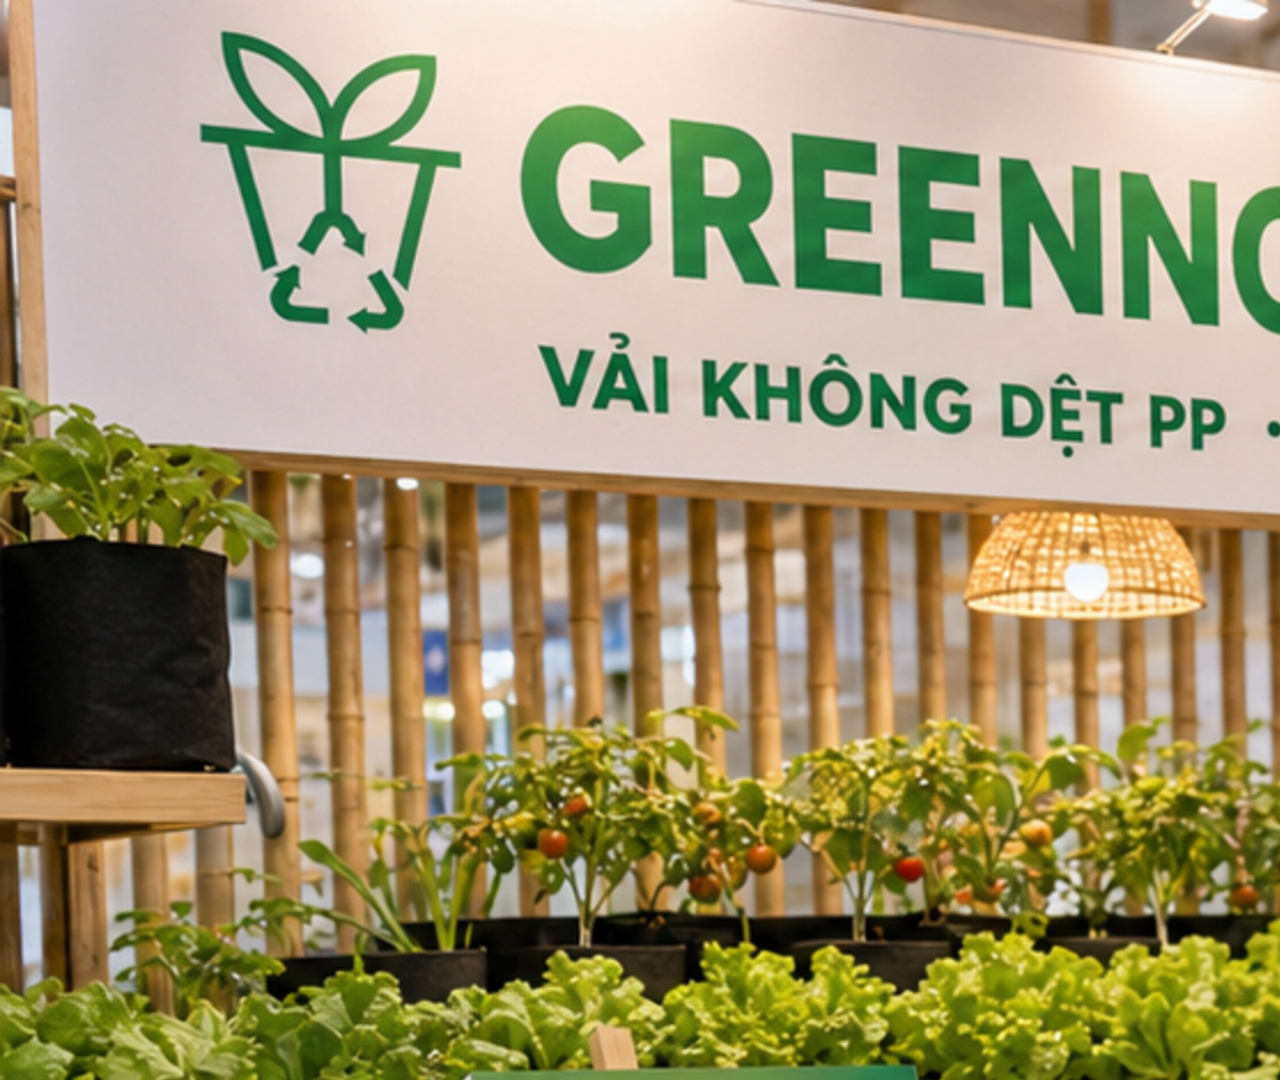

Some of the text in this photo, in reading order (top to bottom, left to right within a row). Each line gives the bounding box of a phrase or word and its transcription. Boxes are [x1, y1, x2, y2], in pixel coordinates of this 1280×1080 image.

[538, 332, 669, 414] VẢI
[701, 353, 972, 434] KHÔNG
[1000, 373, 1123, 457] DỆT
[1149, 394, 1226, 451] PP
